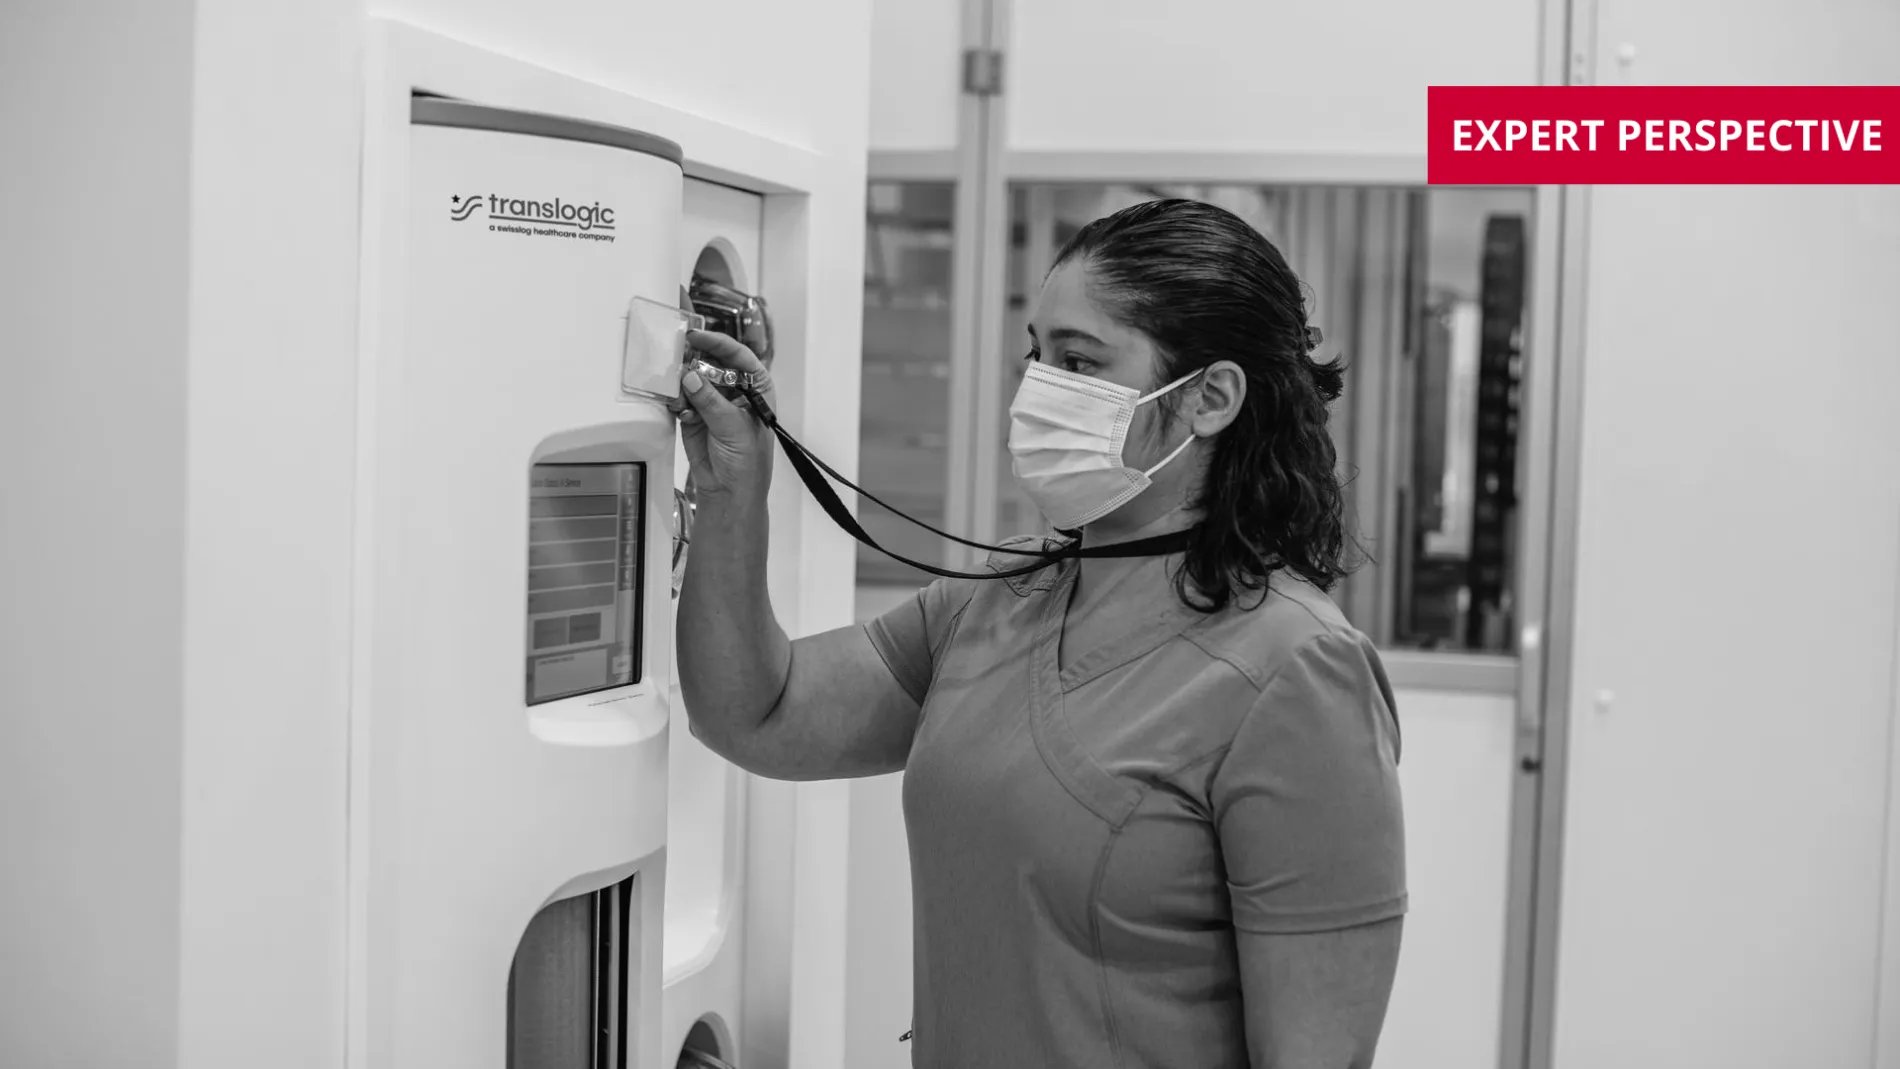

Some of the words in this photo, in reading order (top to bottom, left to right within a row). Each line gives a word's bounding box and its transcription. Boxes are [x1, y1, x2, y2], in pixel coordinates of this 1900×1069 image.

[488, 193, 615, 230] translogic
[497, 224, 532, 236] swisslog
[533, 227, 577, 239] healthcare
[578, 232, 615, 243] company
